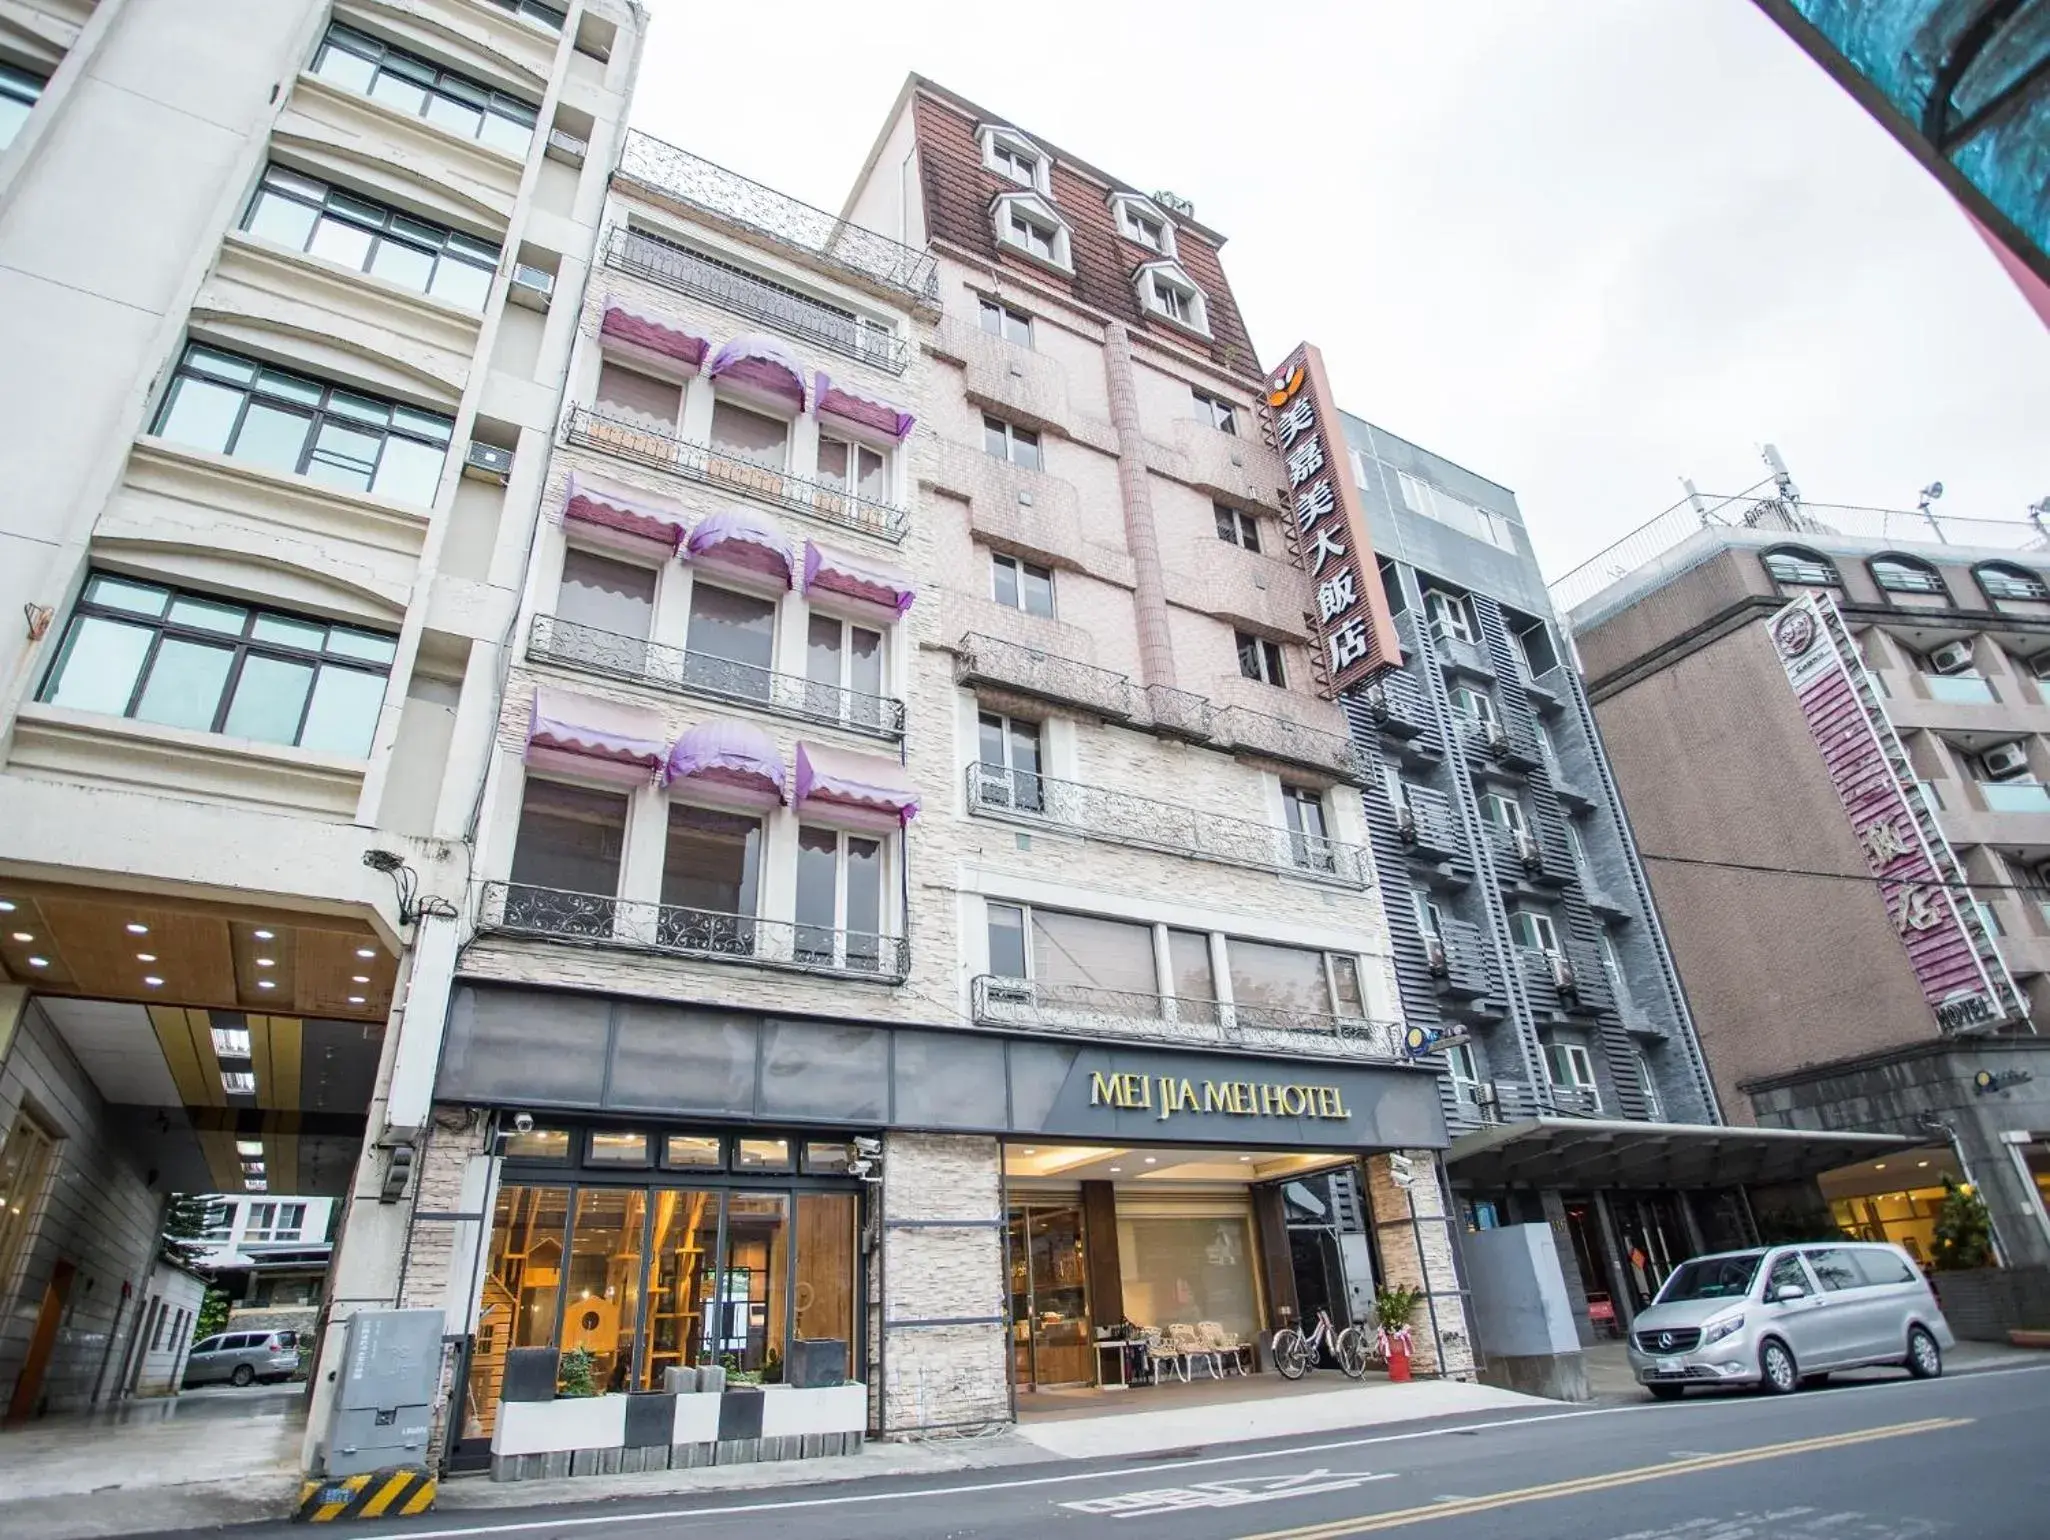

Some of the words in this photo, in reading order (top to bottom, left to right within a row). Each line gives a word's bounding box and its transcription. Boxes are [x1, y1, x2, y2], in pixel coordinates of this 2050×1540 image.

[1276, 395, 1369, 676] 美嘉美大飯店
[1089, 1071, 1153, 1109] MEI
[1157, 1077, 1201, 1121] JIA
[1202, 1080, 1259, 1115] MEI
[1260, 1084, 1353, 1119] HOTEL
